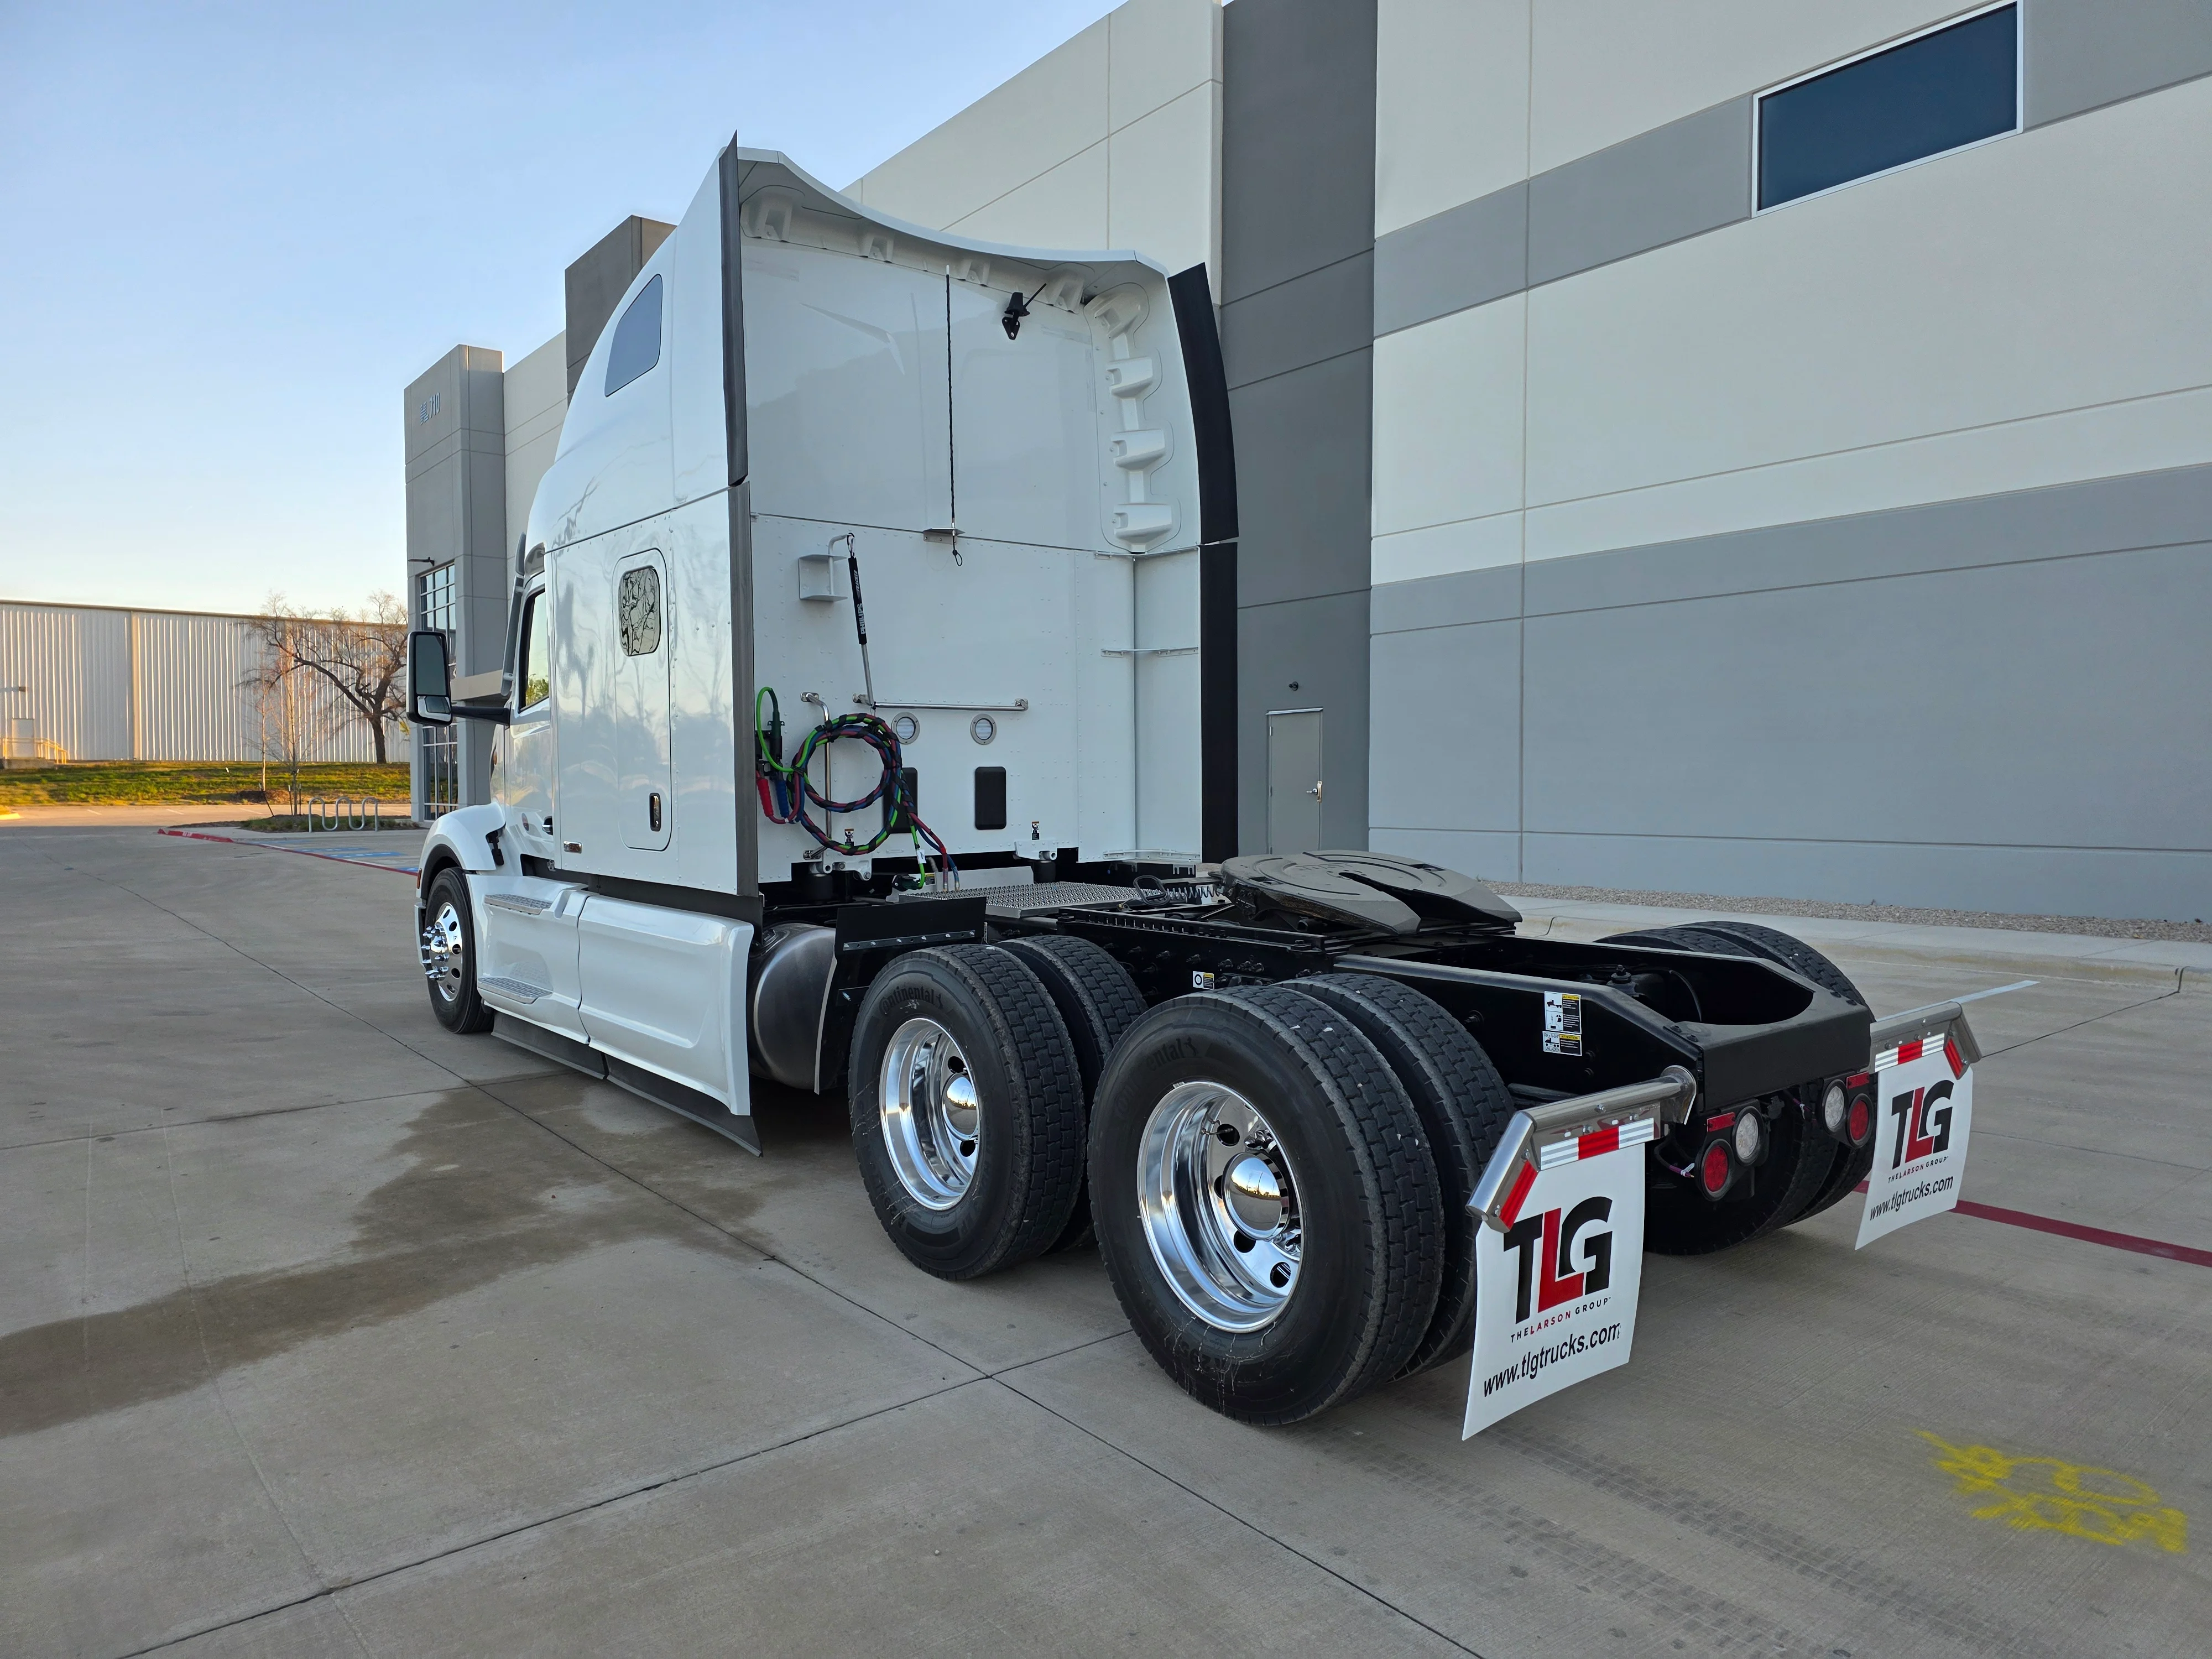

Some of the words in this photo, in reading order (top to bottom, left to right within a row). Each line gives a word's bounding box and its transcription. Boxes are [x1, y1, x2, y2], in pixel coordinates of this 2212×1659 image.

[429, 392, 441, 419] 710
[880, 986, 935, 1015] Continental
[1891, 1079, 1954, 1170] TLG
[1926, 1156, 1947, 1167] GROUP
[1870, 1175, 1954, 1220] www.tlgtrucks.com
[1503, 1196, 1613, 1324] TLG
[1575, 1298, 1608, 1315] GROUP
[1484, 1323, 1620, 1397] www.tlgtrucks.com
